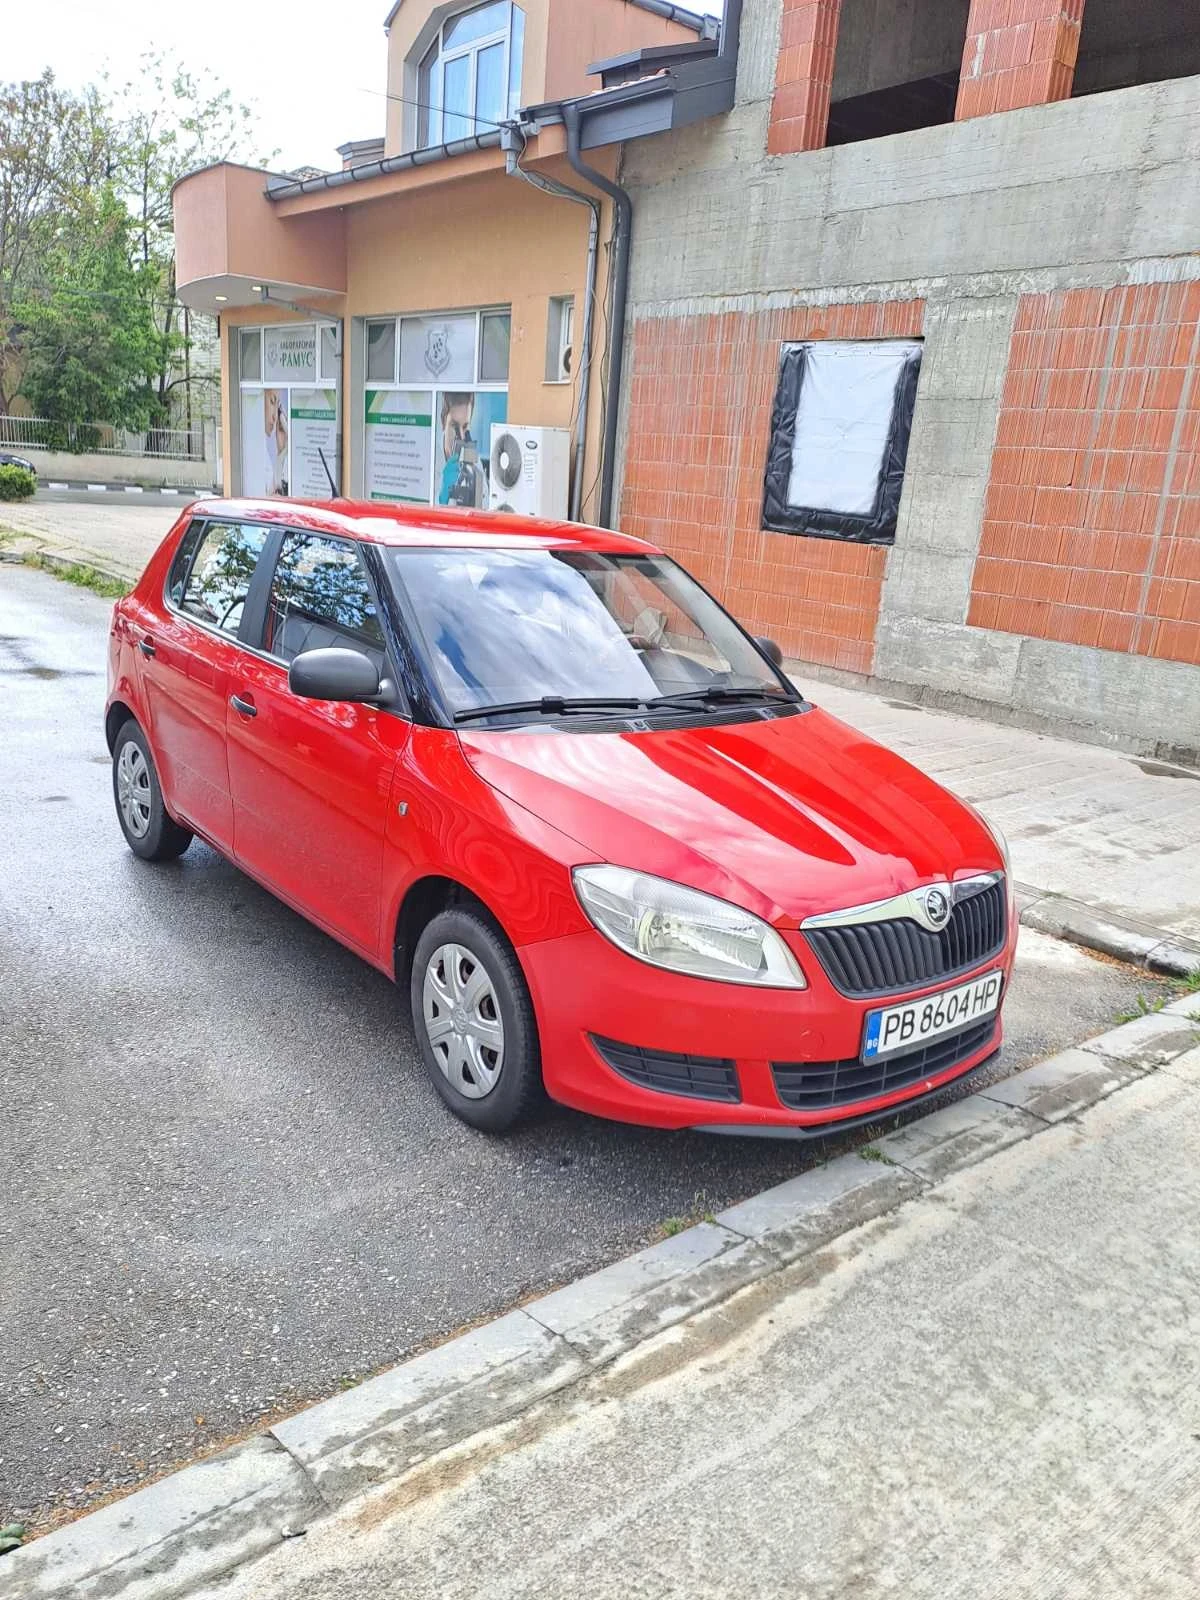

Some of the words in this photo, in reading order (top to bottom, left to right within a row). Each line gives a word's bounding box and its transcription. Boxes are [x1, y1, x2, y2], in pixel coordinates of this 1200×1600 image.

[883, 1009, 915, 1046] PB
[920, 989, 970, 1034] 8604
[972, 978, 997, 1014] HP
[866, 1038, 879, 1050] BG
